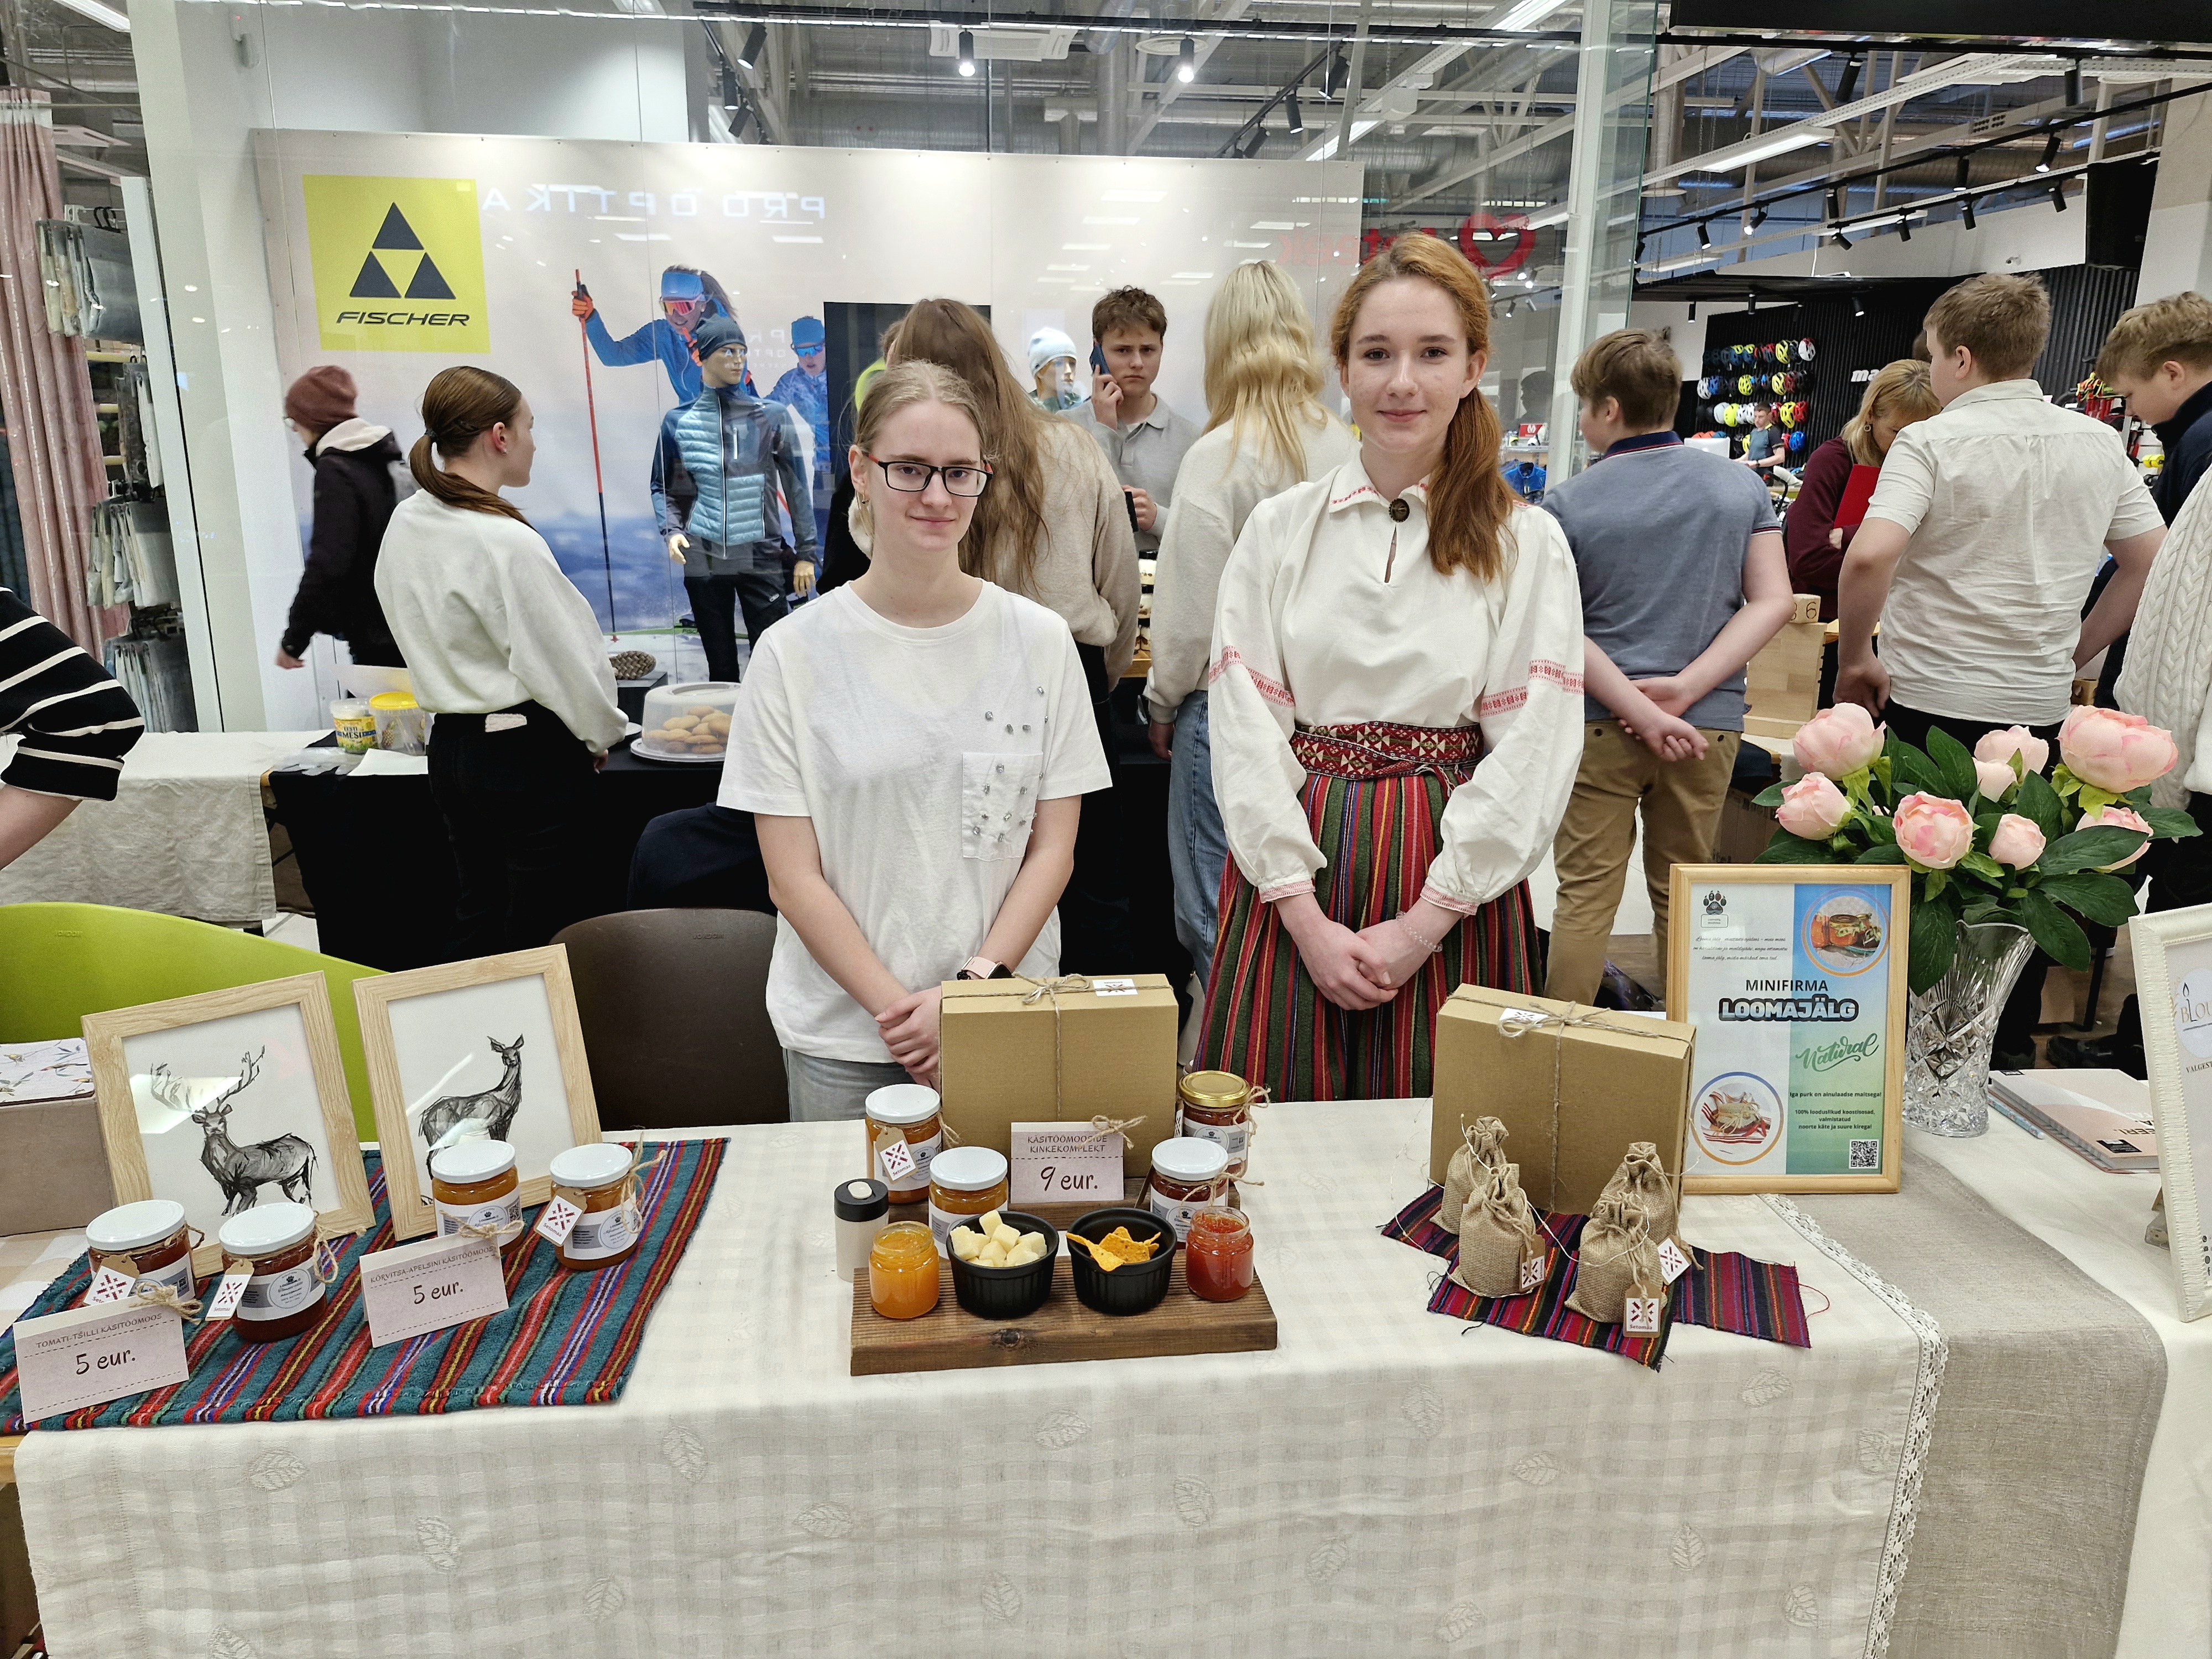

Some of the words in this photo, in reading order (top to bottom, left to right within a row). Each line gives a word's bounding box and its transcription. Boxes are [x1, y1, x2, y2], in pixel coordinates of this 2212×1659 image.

[336, 311, 470, 326] FISCHER
[1745, 979, 1829, 992] MINIFIRMA
[1720, 995, 1858, 1020] LOOMAJÄLG
[1795, 1032, 1879, 1072] Natural
[1030, 1145, 1106, 1154] KINKEKOMPLEKT
[893, 1164, 911, 1176] Setomaa
[1041, 1166, 1056, 1192] 9
[1061, 1174, 1098, 1190] eur.
[542, 1222, 563, 1238] Setomaa
[413, 1284, 426, 1305] 5
[431, 1281, 464, 1300] eur.
[36, 1329, 100, 1349] TOMATI-TŠILLI
[76, 1353, 90, 1375] 5
[96, 1349, 136, 1370] eur.
